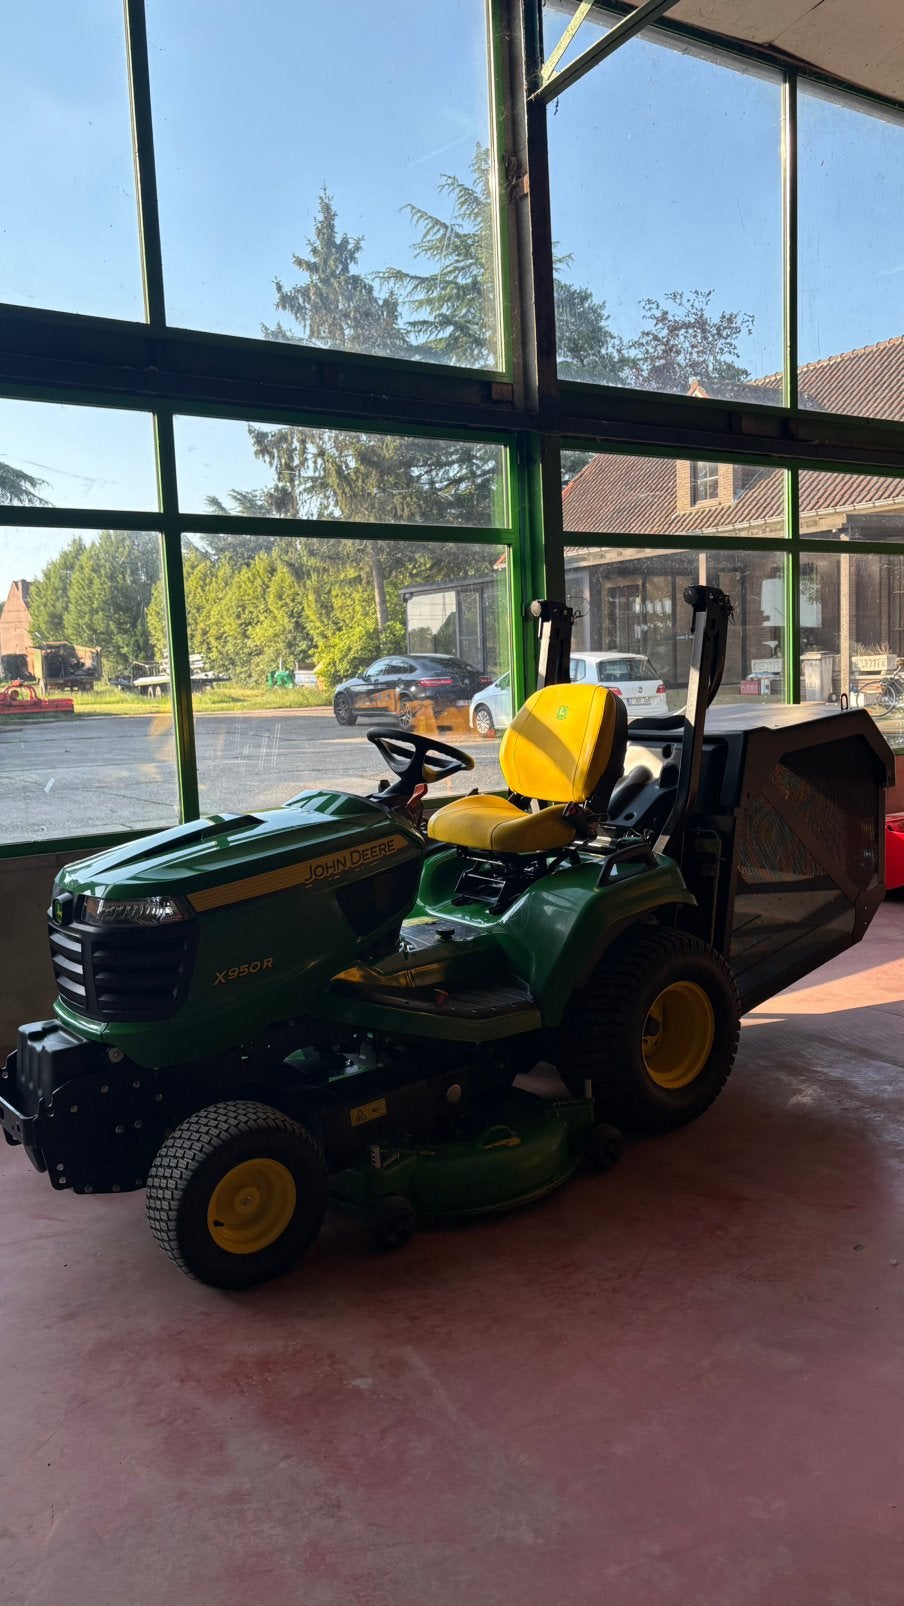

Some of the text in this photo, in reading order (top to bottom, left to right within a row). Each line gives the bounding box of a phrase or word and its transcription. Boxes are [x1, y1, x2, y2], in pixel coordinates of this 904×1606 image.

[305, 839, 395, 882] JOHN DEERE
[213, 957, 274, 985] X950R
